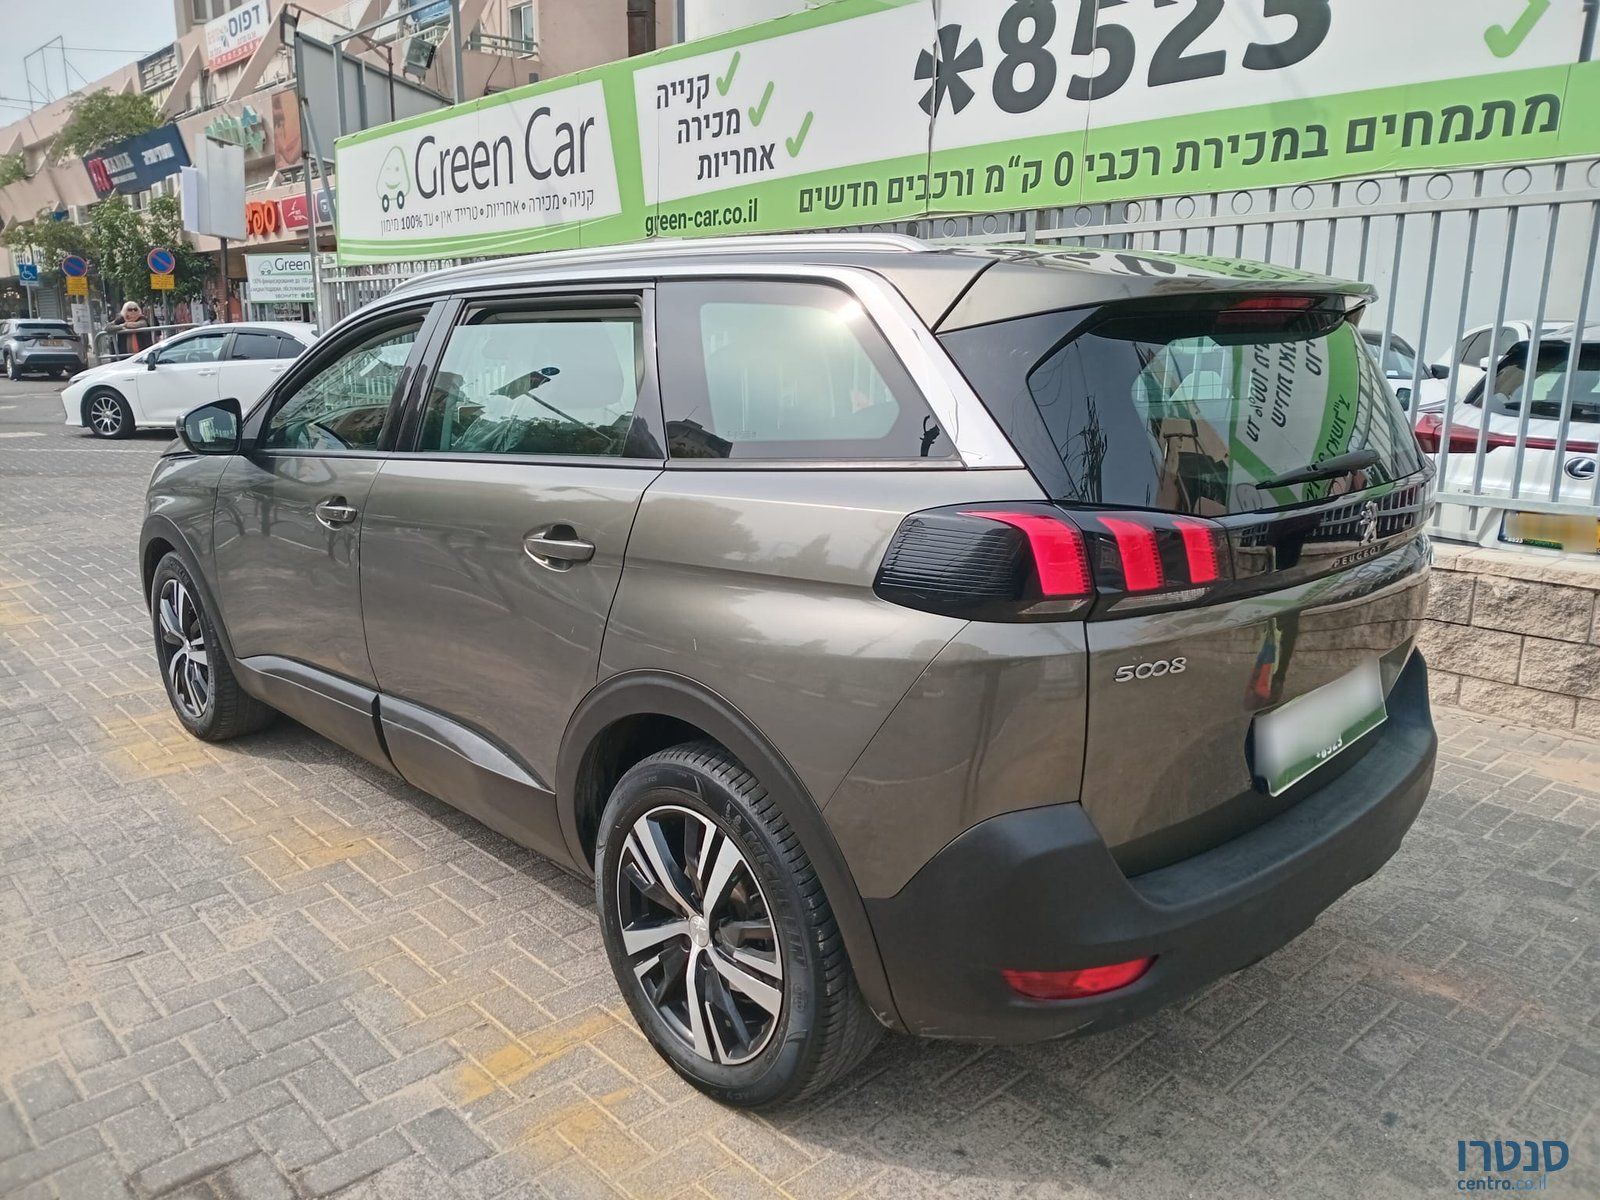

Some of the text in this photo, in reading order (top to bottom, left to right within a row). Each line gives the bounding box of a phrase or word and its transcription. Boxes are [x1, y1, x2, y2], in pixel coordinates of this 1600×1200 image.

[228, 4, 260, 37] דפוס
[656, 74, 710, 109] קנייה
[677, 108, 741, 144] מכירה
[1345, 92, 1562, 154] מתמחים
[415, 106, 594, 199] Green Car
[697, 143, 776, 181] אחריות
[1085, 145, 1161, 183] רכבי
[1172, 124, 1329, 174] במכירת
[1053, 150, 1075, 187] 0
[570, 190, 594, 211] קניה
[799, 179, 878, 213] חדשים
[887, 168, 974, 204] ורכבים
[424, 212, 434, 227] עד
[486, 200, 520, 219] אחריות
[528, 194, 560, 213] מכירה
[645, 198, 758, 237] green-car.co.il
[380, 218, 400, 237] מימון
[401, 214, 423, 230] 100%
[274, 257, 310, 272] Green
[1333, 545, 1381, 568] PEUGEOT
[1114, 656, 1187, 682] 5008
